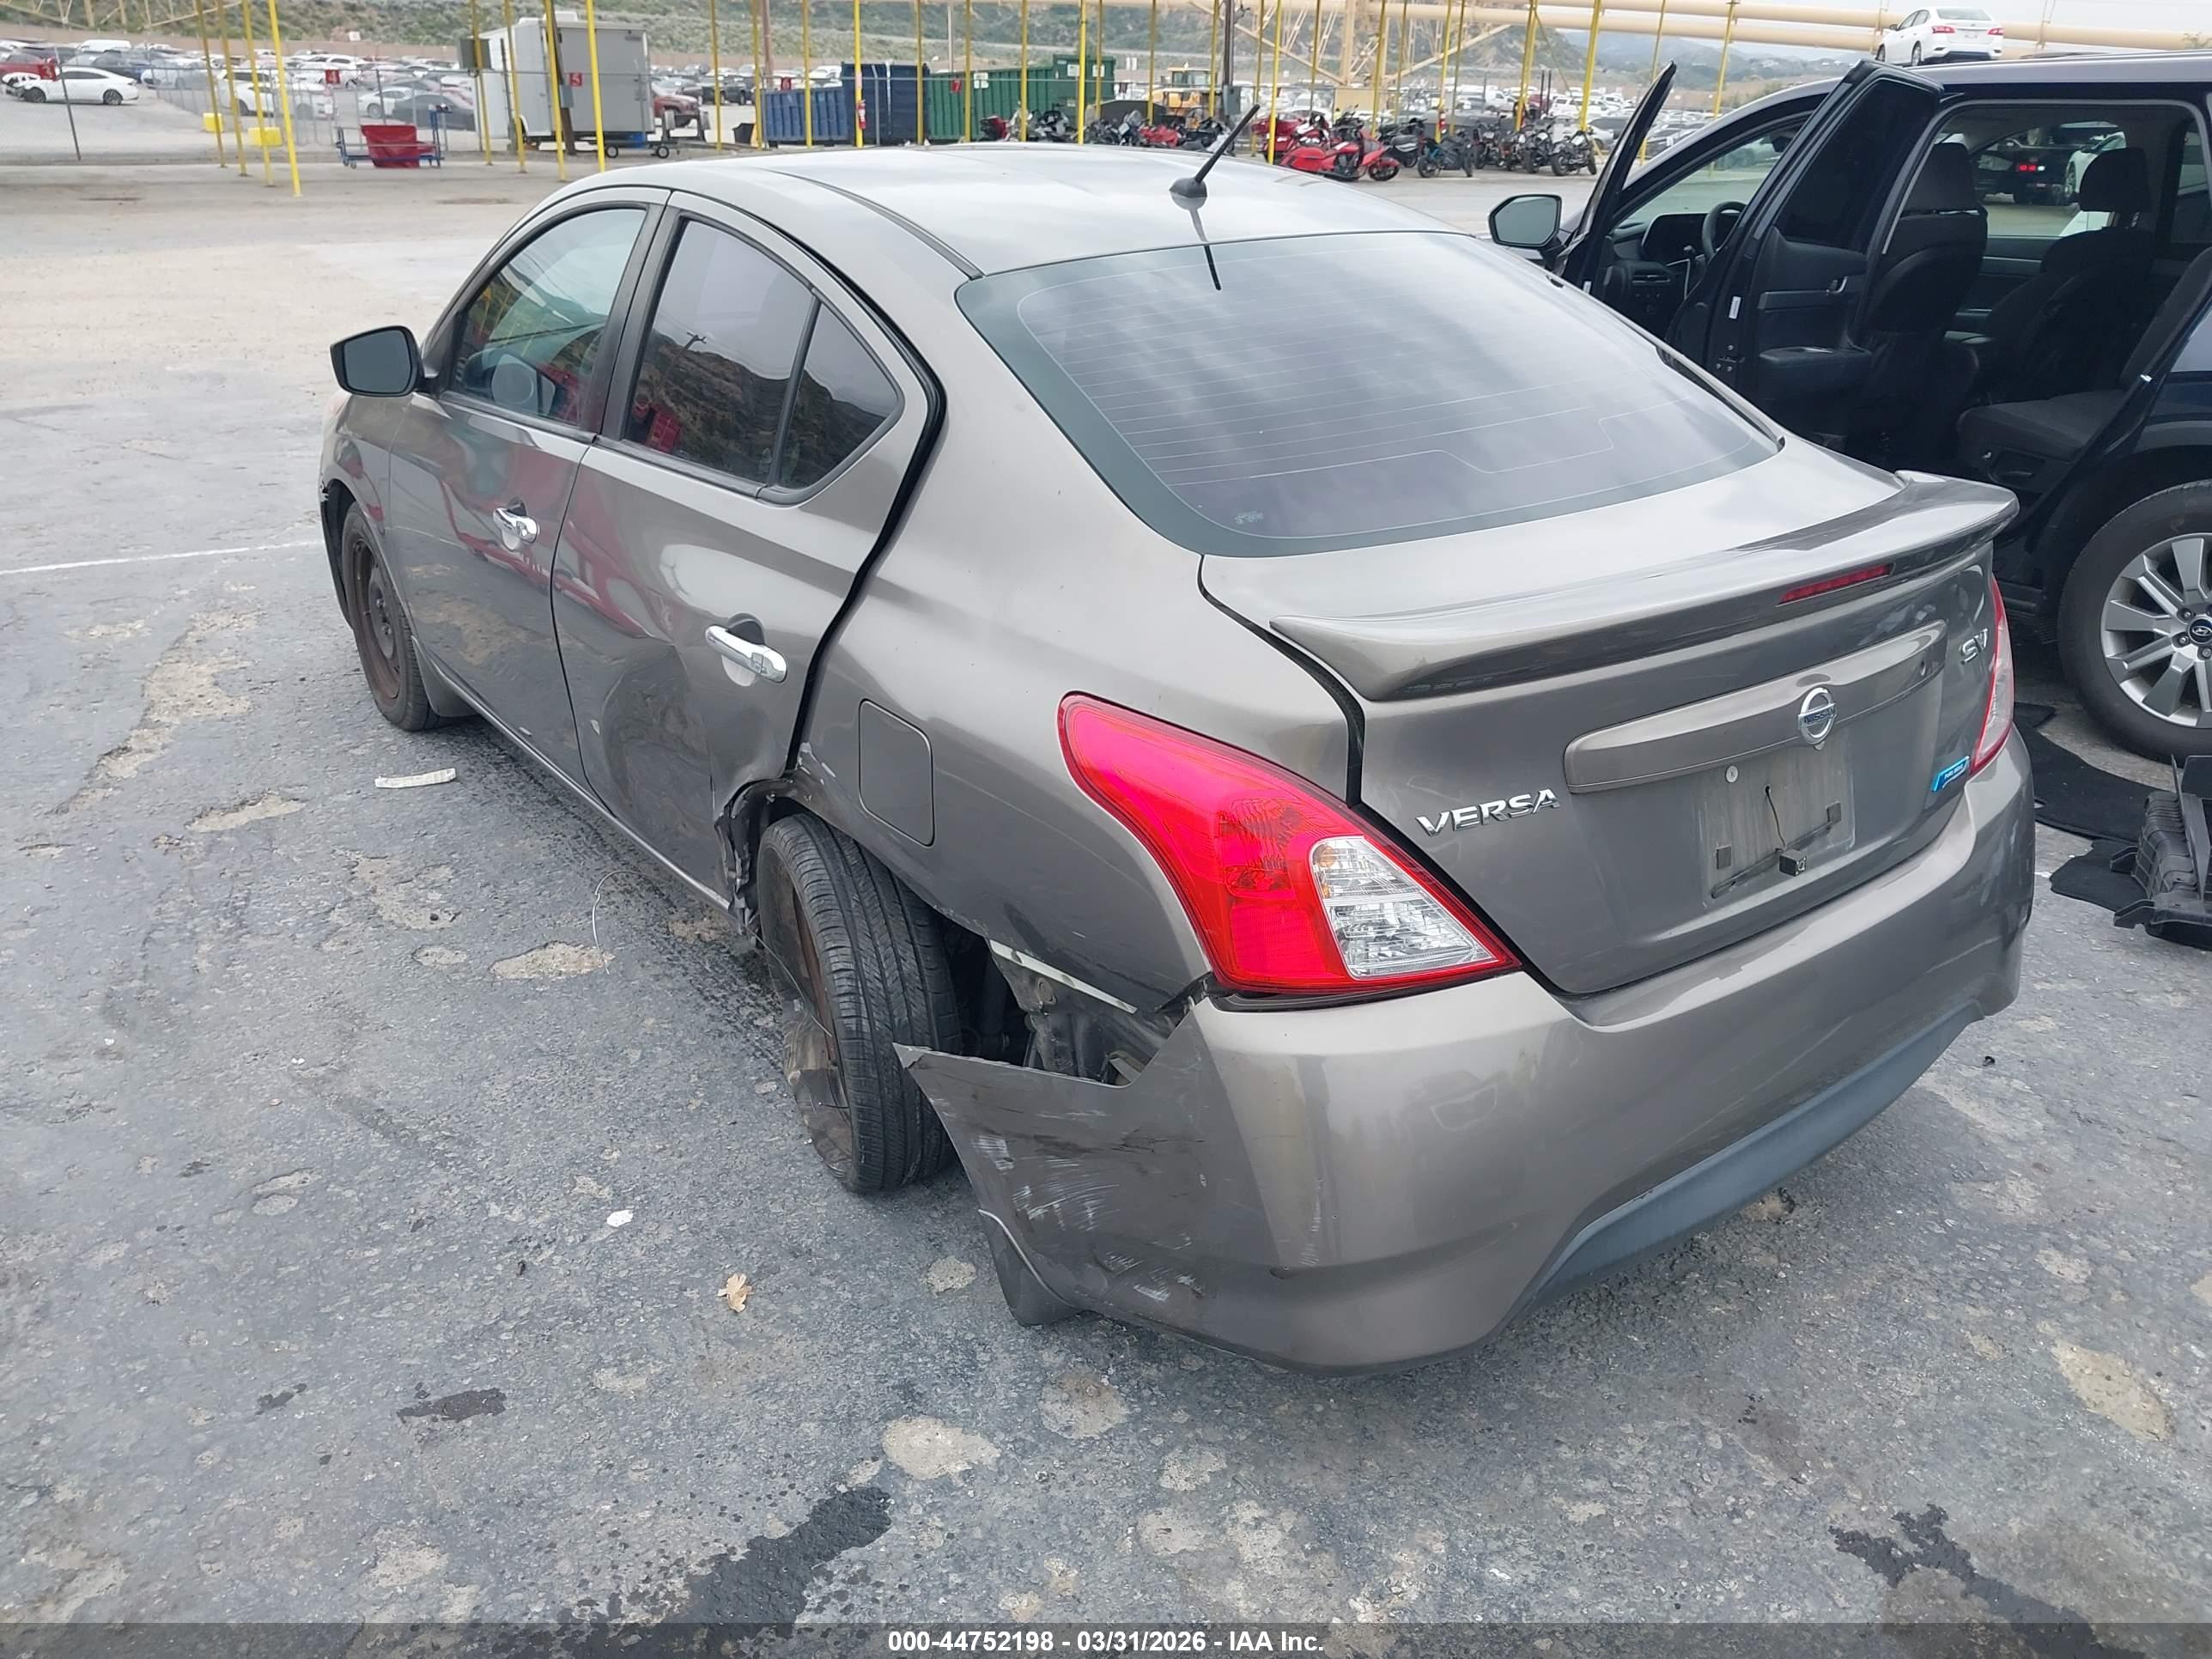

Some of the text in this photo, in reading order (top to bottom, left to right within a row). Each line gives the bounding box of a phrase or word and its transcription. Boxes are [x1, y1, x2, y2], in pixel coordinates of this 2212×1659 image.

[328, 70, 337, 83] 4
[571, 73, 580, 86] 5
[1959, 628, 1988, 665] SV
[1415, 787, 1561, 837] VERSA
